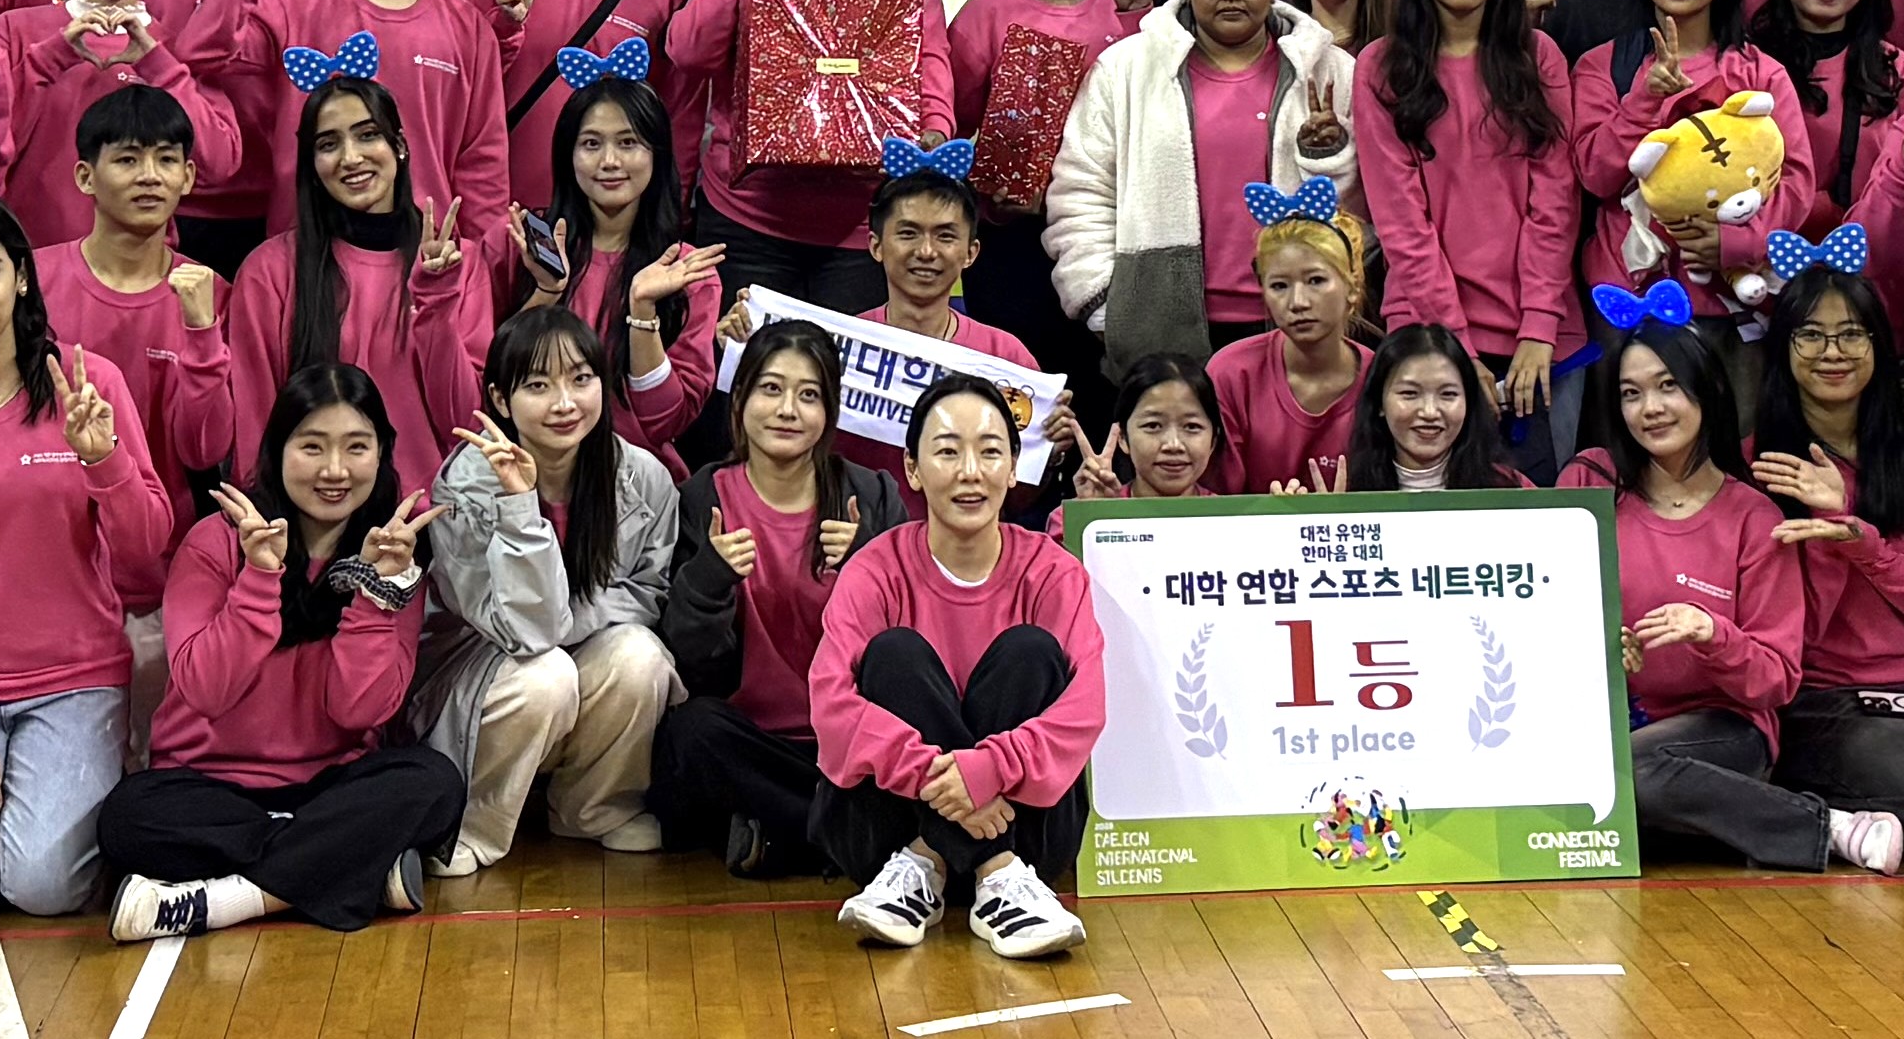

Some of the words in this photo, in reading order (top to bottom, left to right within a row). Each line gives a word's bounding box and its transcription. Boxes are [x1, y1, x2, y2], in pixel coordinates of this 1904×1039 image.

[846, 388, 913, 424] UNIVE
[1300, 525, 1331, 543] 대전
[1335, 523, 1381, 542] 유학생
[1301, 545, 1348, 563] 한마음
[1352, 544, 1384, 561] 대회
[1165, 571, 1227, 606] 대학
[1236, 568, 1299, 605] 연합
[1308, 567, 1403, 599] 스포츠
[1412, 563, 1534, 599] 네트워킹
[1275, 619, 1419, 711] 1등
[1272, 725, 1320, 755] 1st
[1331, 724, 1416, 761] place
[1527, 830, 1620, 850] CONNECTING
[1558, 849, 1622, 868] FESTIVAL
